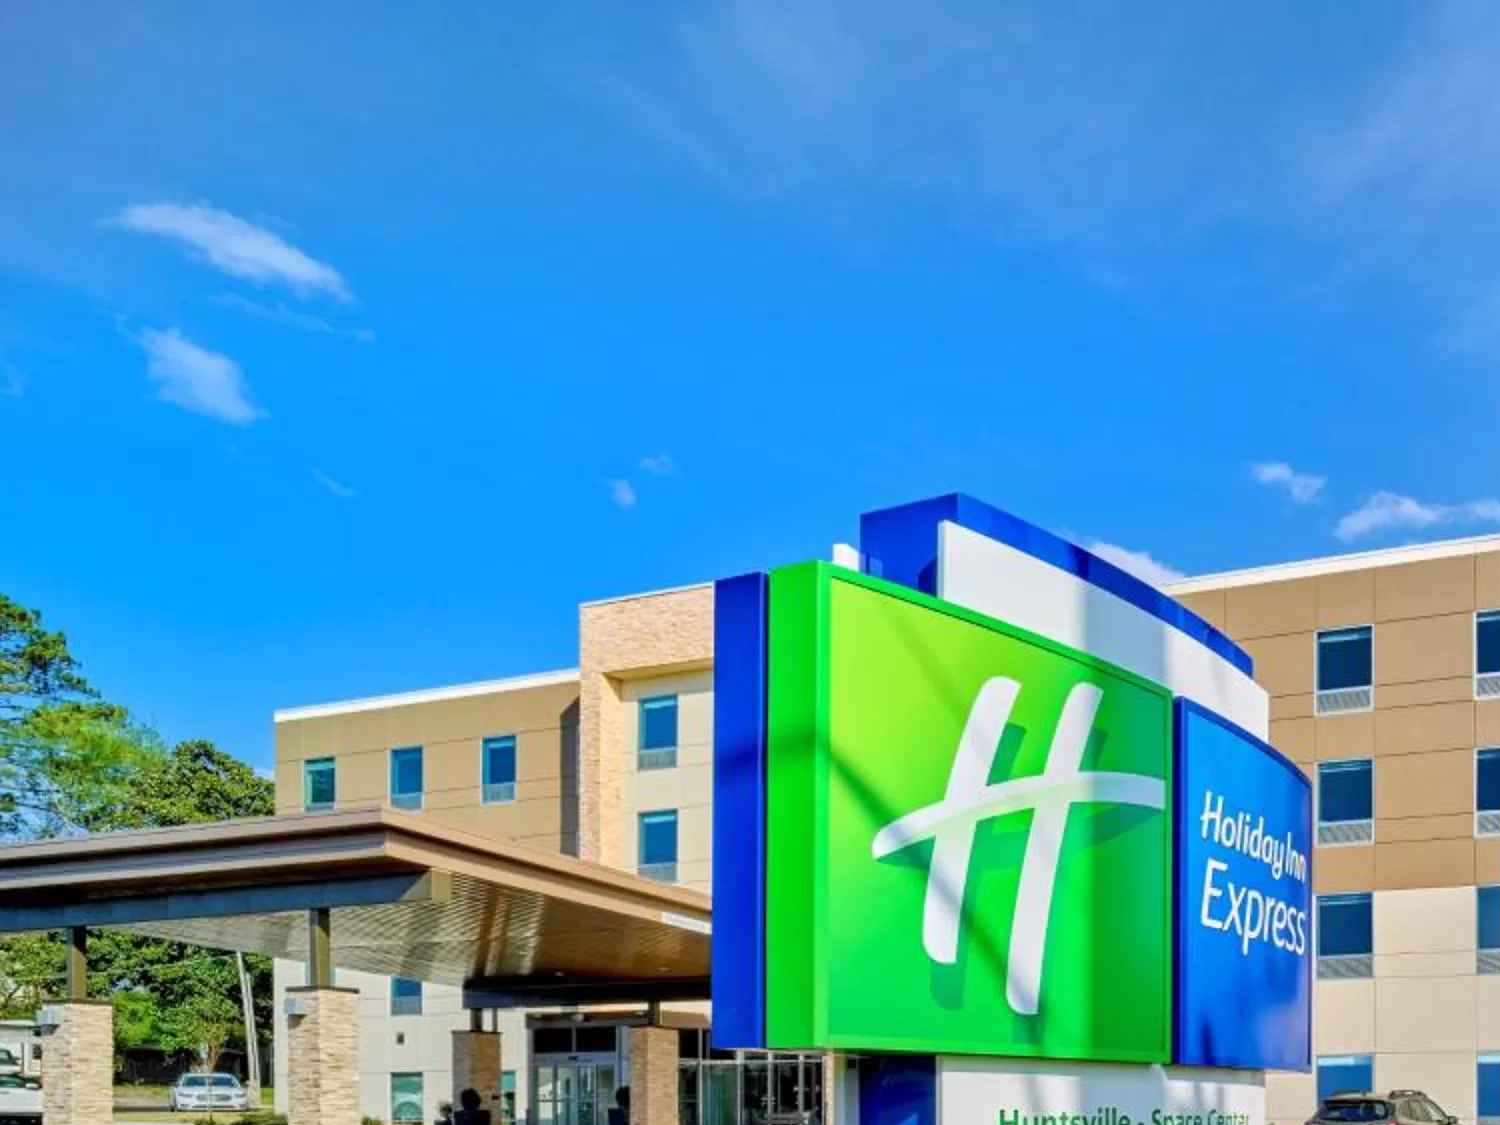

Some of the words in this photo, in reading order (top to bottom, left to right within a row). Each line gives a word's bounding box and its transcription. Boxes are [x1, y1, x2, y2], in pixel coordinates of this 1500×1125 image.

[1200, 790, 1284, 880] Holiday
[1285, 832, 1306, 884] Inn
[1201, 858, 1307, 956] Express
